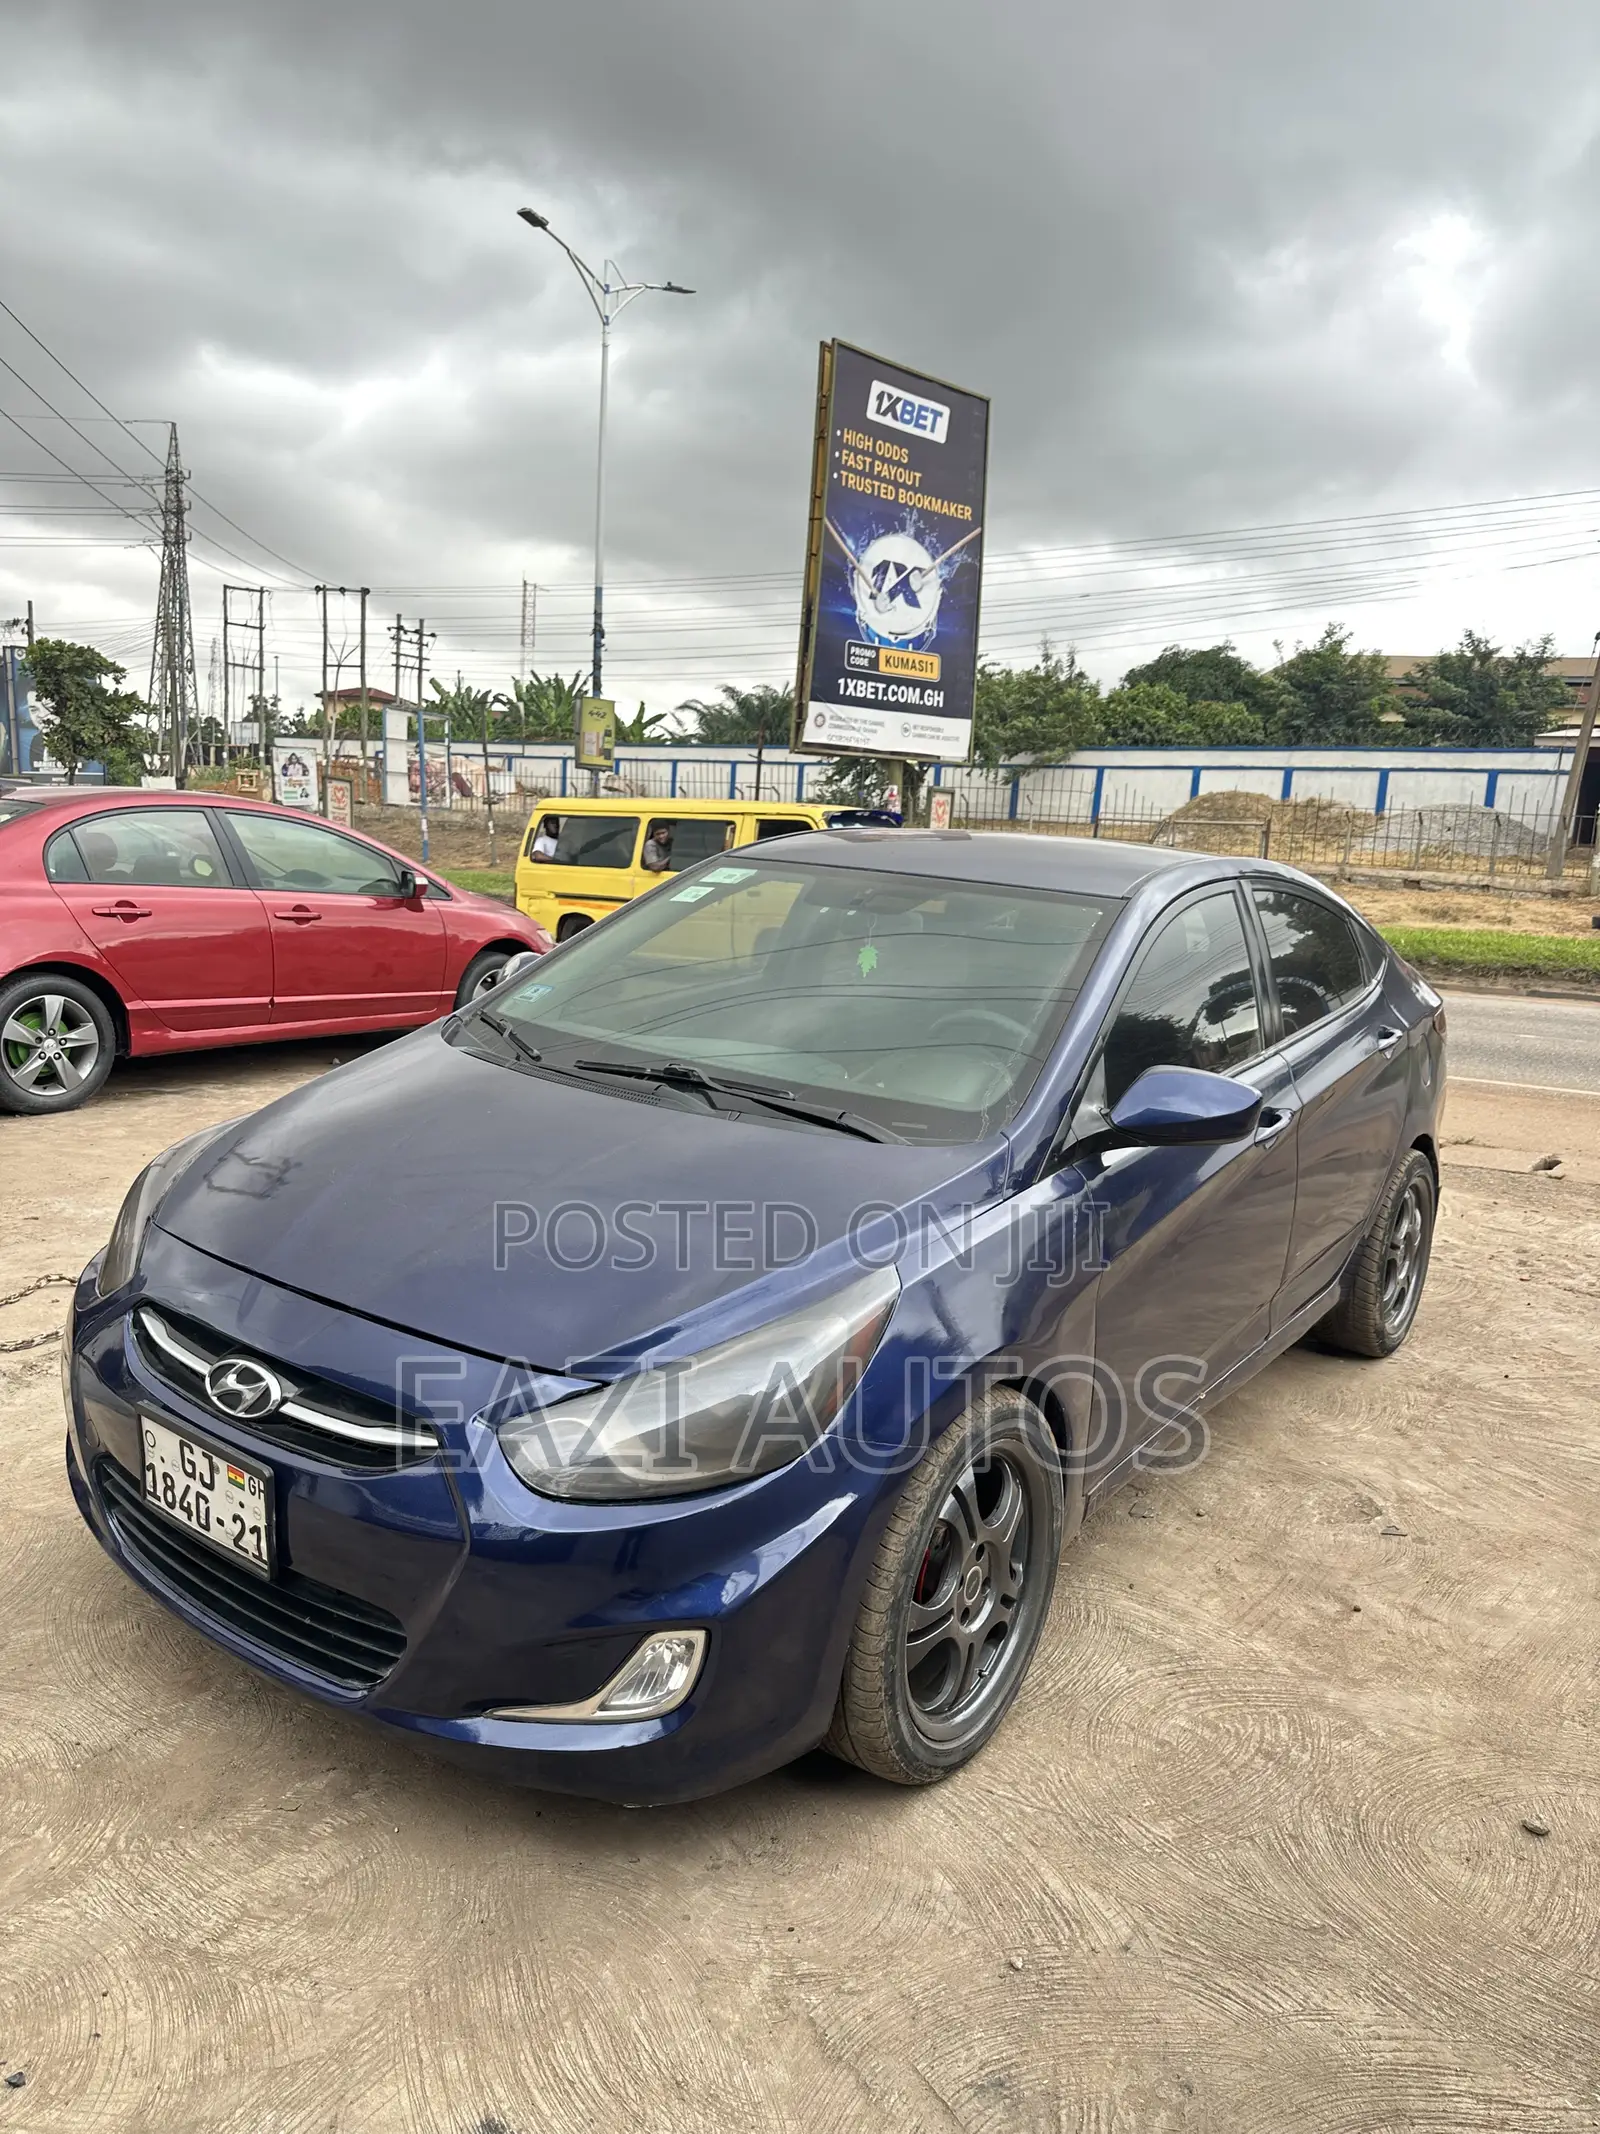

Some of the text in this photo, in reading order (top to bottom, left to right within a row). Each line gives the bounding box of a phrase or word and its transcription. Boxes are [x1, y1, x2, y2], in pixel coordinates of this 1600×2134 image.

[875, 390, 943, 434] 1XBET
[843, 428, 909, 464] HIGH ODDS
[841, 449, 922, 488] FAST PAYOUT
[840, 470, 973, 521] TRUSTED BOOKMAKER
[850, 645, 876, 659] PROMO
[850, 655, 870, 667] CODE
[884, 655, 934, 674] KUMASI1
[837, 678, 945, 708] 1XBET.COM.GH
[179, 1439, 215, 1491] GJ
[146, 1462, 268, 1565] 1840-21
